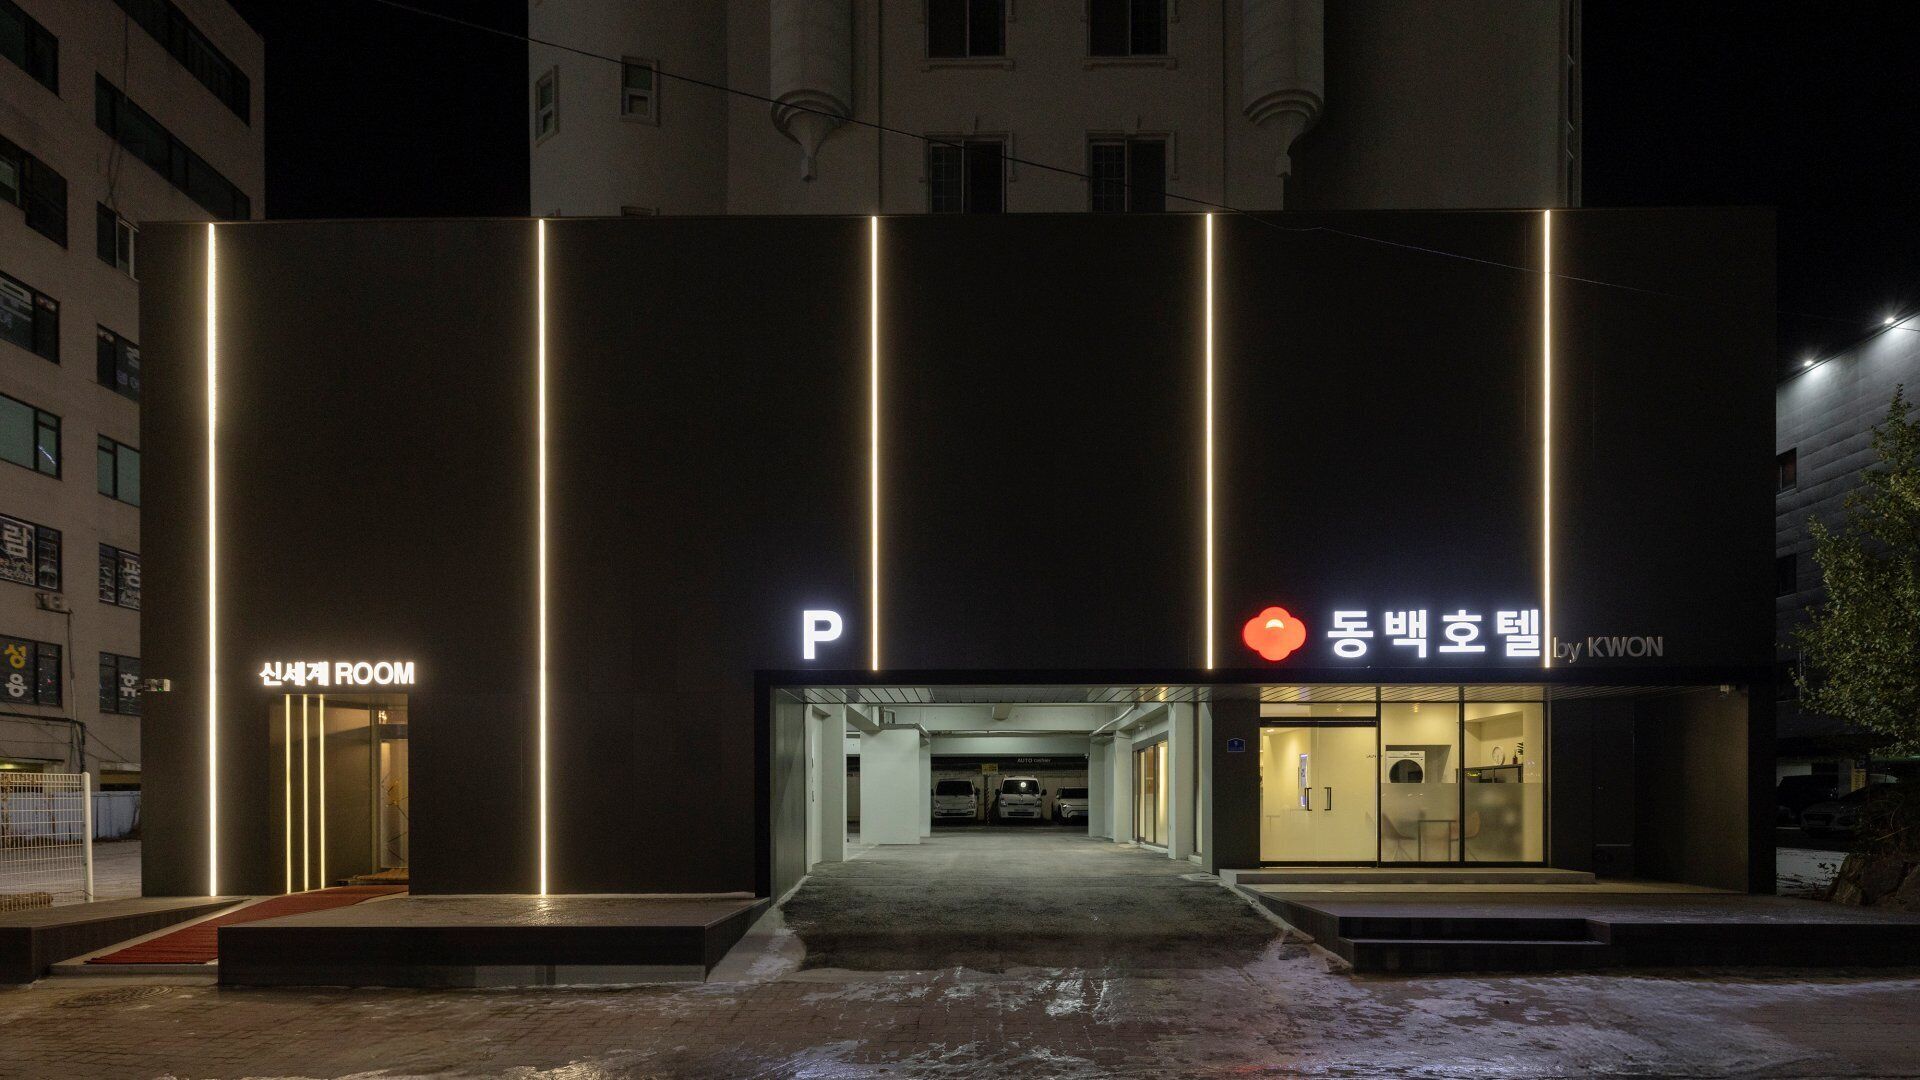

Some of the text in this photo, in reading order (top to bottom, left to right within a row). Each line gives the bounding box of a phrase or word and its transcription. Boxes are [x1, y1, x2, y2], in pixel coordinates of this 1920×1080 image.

[803, 610, 843, 660] P
[1327, 609, 1664, 663] 동백호텔 by KWON
[5, 673, 28, 697] 용
[259, 661, 415, 686] 신세계 ROOM
